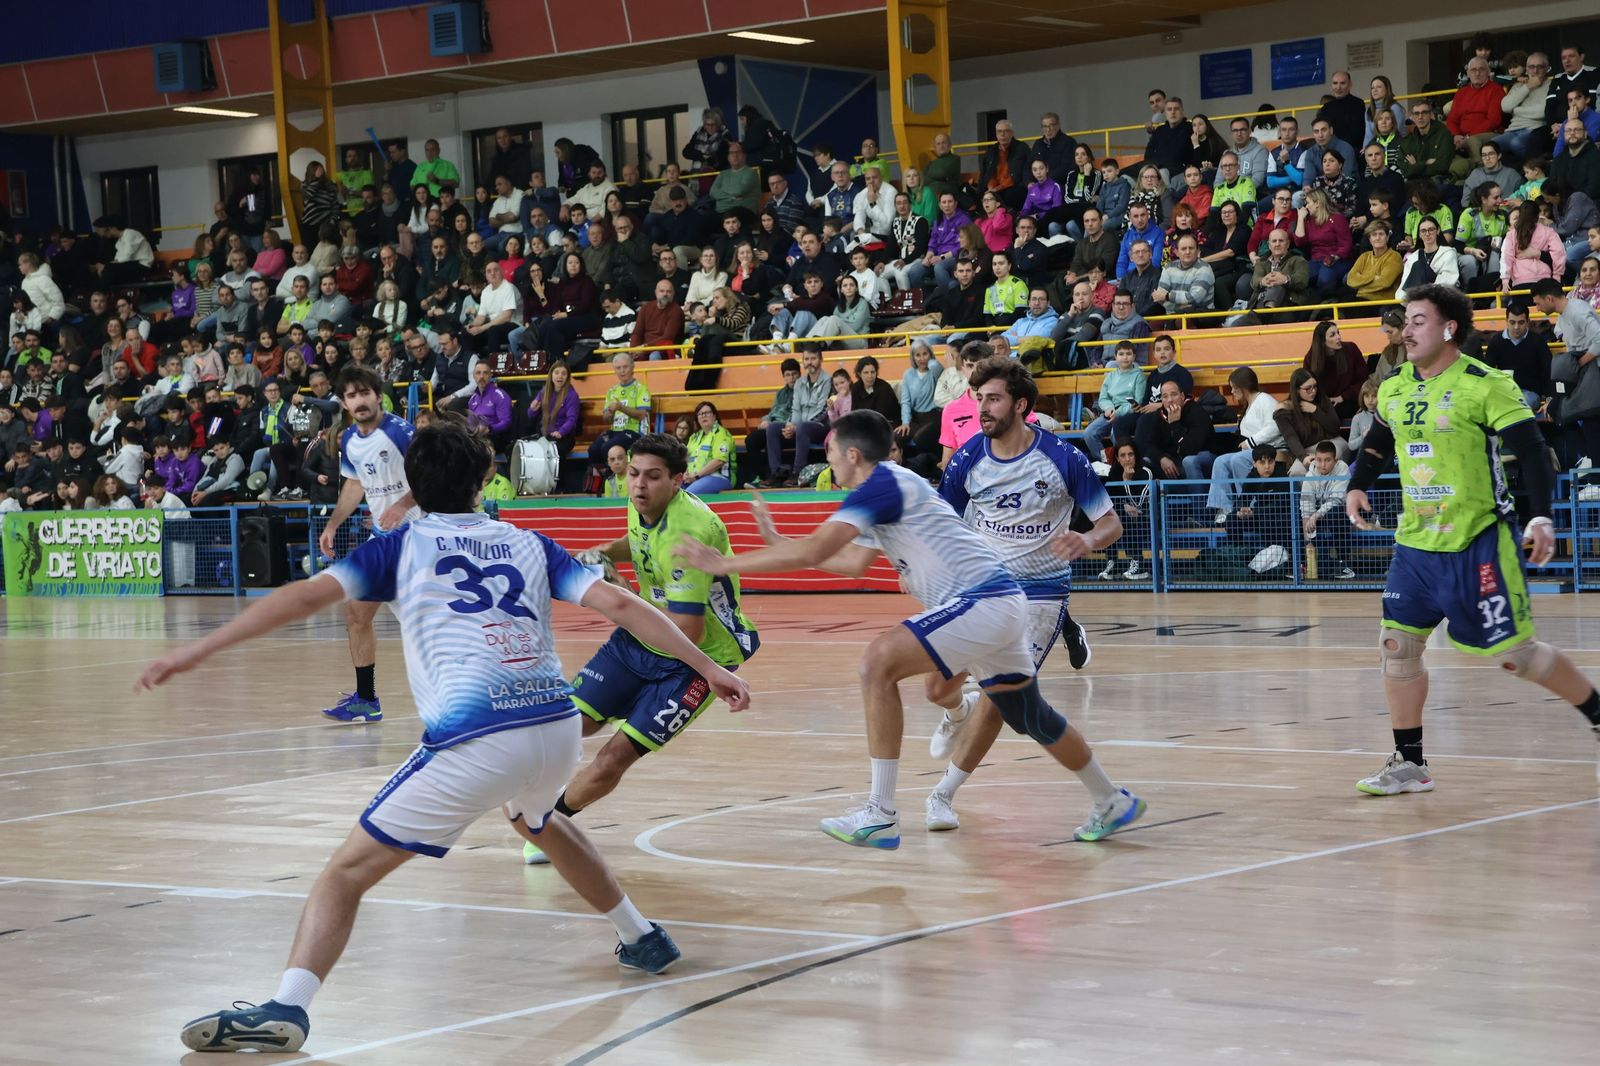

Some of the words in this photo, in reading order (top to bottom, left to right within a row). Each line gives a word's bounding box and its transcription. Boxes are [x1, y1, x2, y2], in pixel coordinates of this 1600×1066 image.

[1402, 401, 1429, 425] 32
[1409, 444, 1430, 456] gaza
[995, 492, 1022, 509] 23
[1421, 486, 1454, 495] RURAL
[38, 517, 162, 547] GUERREROS
[455, 536, 513, 560] MULLOR
[49, 551, 78, 579] DE
[83, 551, 162, 580] VIRIATO
[435, 555, 538, 621] 32
[1477, 595, 1511, 628] 32
[487, 683, 511, 699] LA
[514, 676, 563, 696] SALLE
[491, 690, 568, 711] MARAVILLAS
[653, 698, 691, 733] 26
